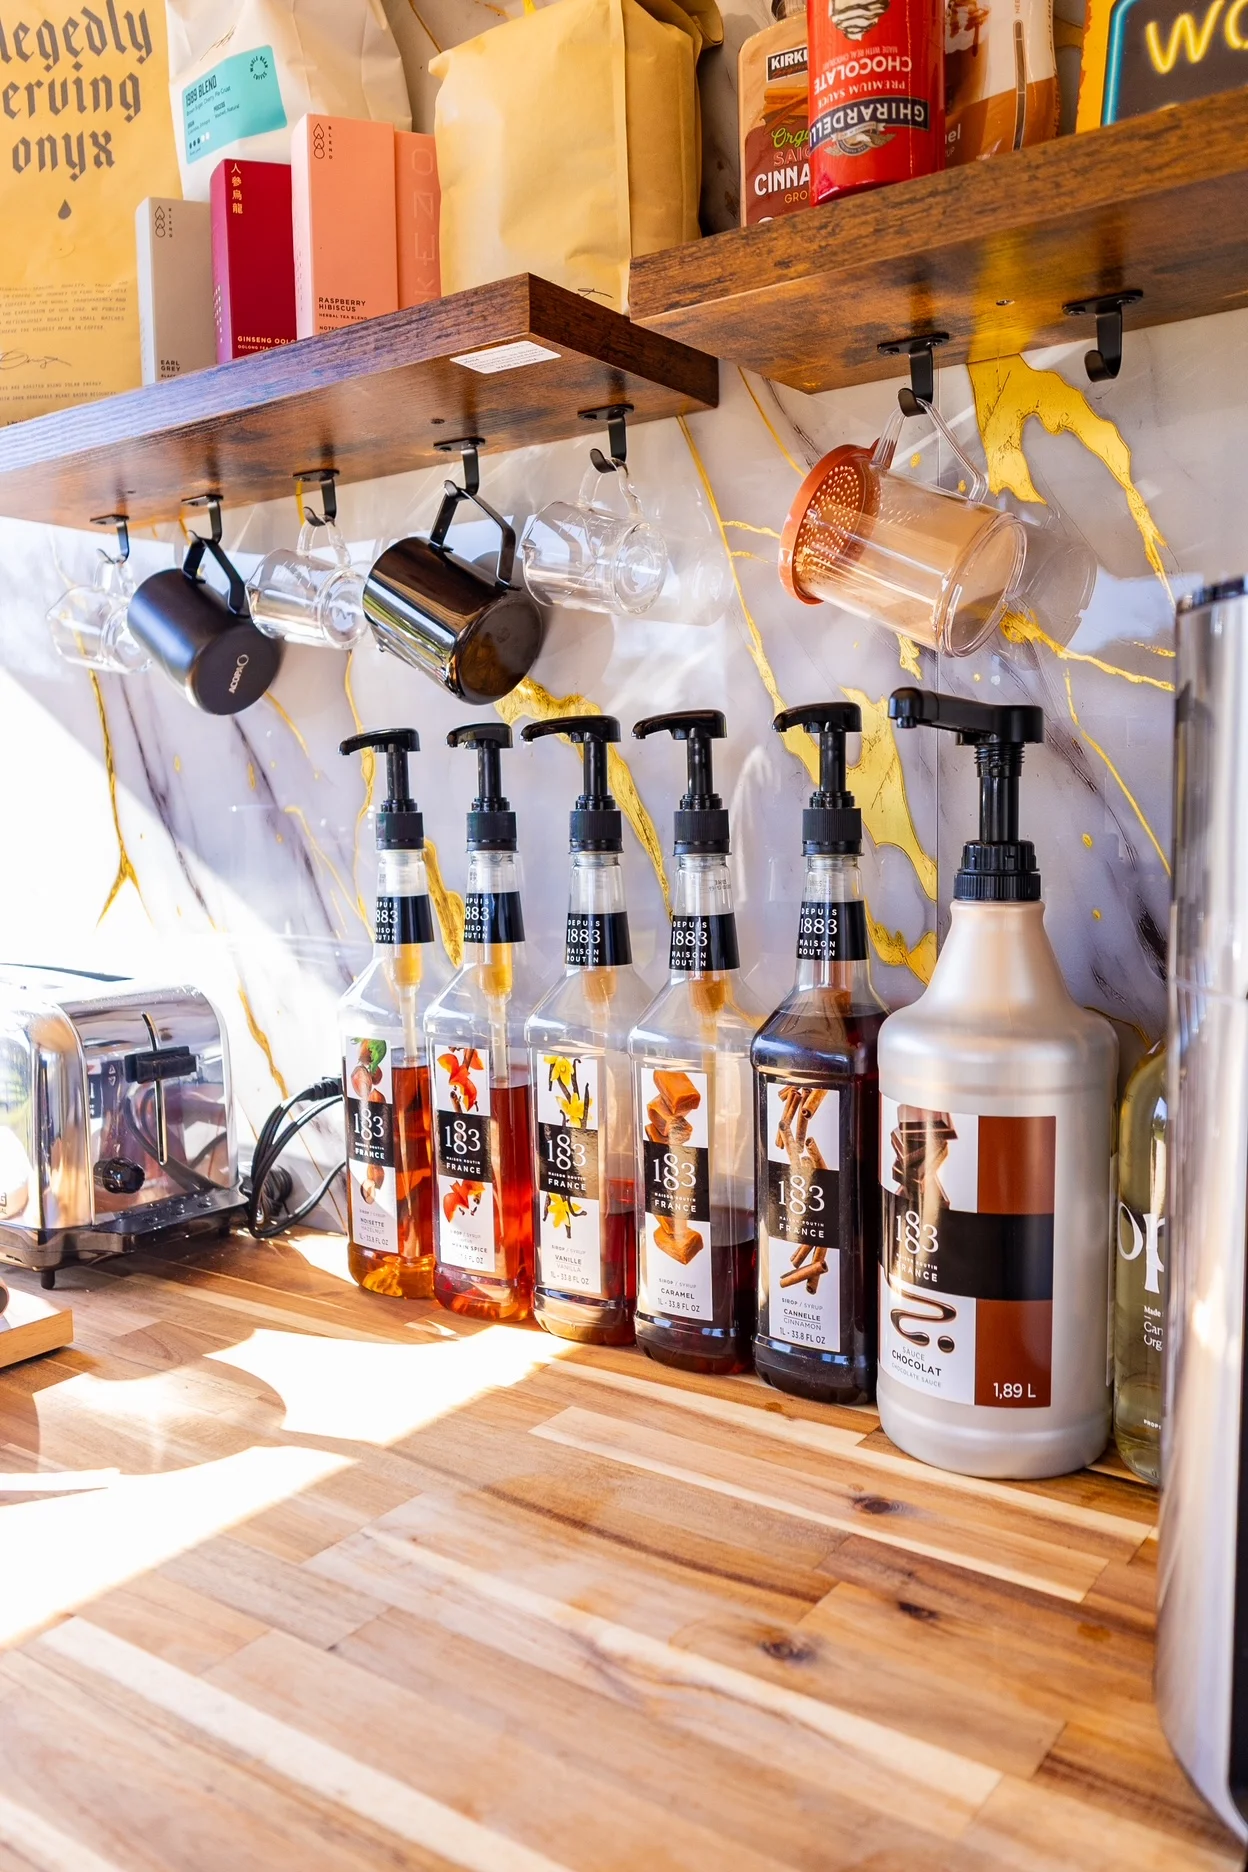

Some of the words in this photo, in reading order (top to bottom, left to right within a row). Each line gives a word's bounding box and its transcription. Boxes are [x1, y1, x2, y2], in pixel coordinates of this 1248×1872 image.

[813, 55, 912, 95] CHOCOLATE
[198, 74, 218, 98] BLEND
[849, 79, 906, 96] PREMIUM
[817, 87, 846, 109] SAUCE
[12, 130, 115, 181] onyx
[318, 296, 366, 307] RASPBERRY
[318, 303, 357, 313] HIBISCUS
[237, 335, 272, 344] GINSENG
[801, 907, 838, 916] DEPUIS
[800, 918, 838, 935] 1883
[567, 928, 601, 944] 1883
[672, 930, 708, 947] 1883
[799, 939, 836, 948] MAISON
[798, 948, 835, 957] ROUTIN
[355, 1147, 385, 1160] FRANCE
[446, 1162, 481, 1175] FRANCE
[548, 1178, 587, 1191] FRANCE
[654, 1199, 697, 1213] FRANCE
[360, 1217, 385, 1228] NOISETTE
[779, 1222, 825, 1239] FRANCE
[471, 1245, 488, 1254] SPICE
[555, 1254, 582, 1265] VANILLE
[660, 1287, 695, 1300] CARAMEL
[690, 1304, 700, 1313] OZ
[783, 1308, 821, 1321] CANNELLE
[1143, 1304, 1162, 1318] Made
[783, 1317, 822, 1331] CINNAMON
[815, 1335, 826, 1345] OZ
[902, 1346, 925, 1361] SAUCE
[891, 1349, 942, 1376] CHOCOLAT
[891, 1362, 919, 1382] CHOCOLATE
[921, 1377, 941, 1389] SAUCE
[993, 1382, 1023, 1399] 1,89
[1027, 1383, 1036, 1398] L
